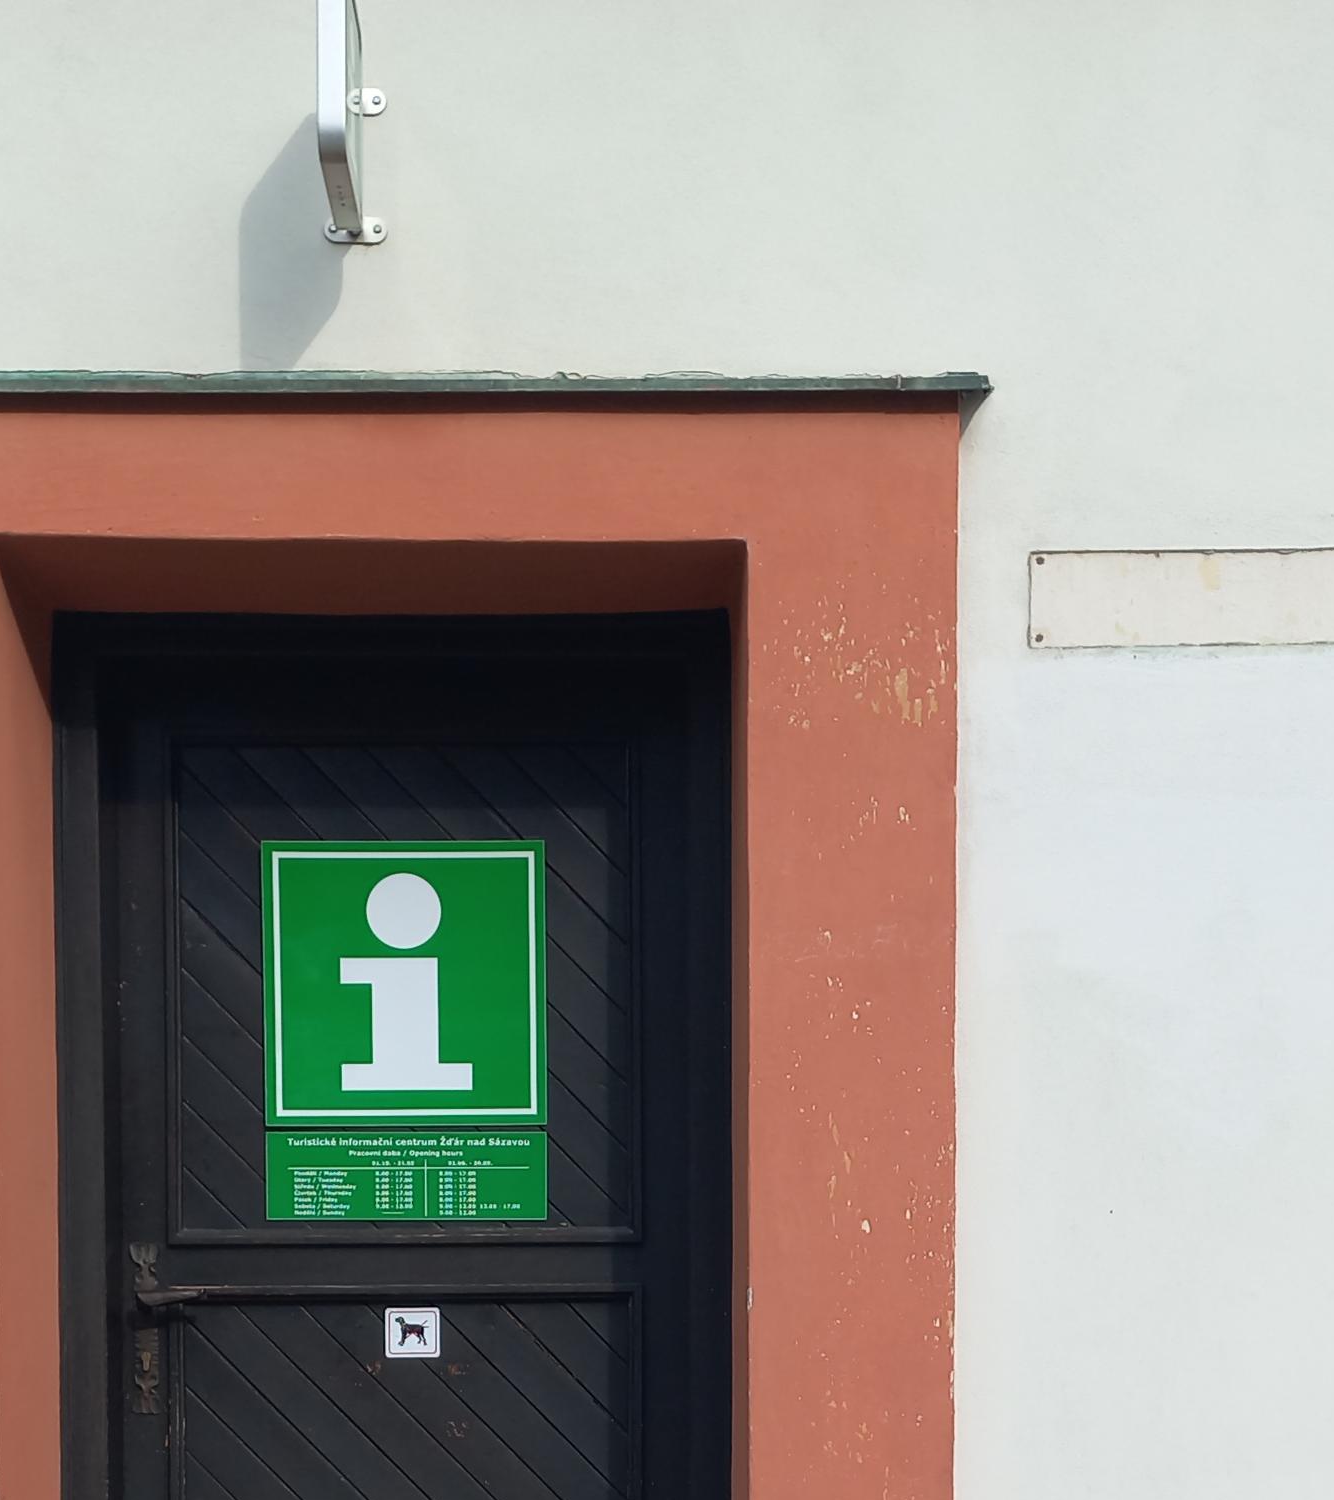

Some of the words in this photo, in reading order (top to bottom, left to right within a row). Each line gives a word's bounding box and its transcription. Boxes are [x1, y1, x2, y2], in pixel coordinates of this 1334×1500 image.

[339, 872, 473, 1091] i
[287, 1137, 337, 1146] Turistické
[339, 1137, 393, 1146] informační
[395, 1138, 437, 1146] centrum
[440, 1136, 464, 1146] Žďár
[467, 1137, 485, 1146] nad
[488, 1137, 530, 1146] Sázavou
[409, 1150, 440, 1158] Opening
